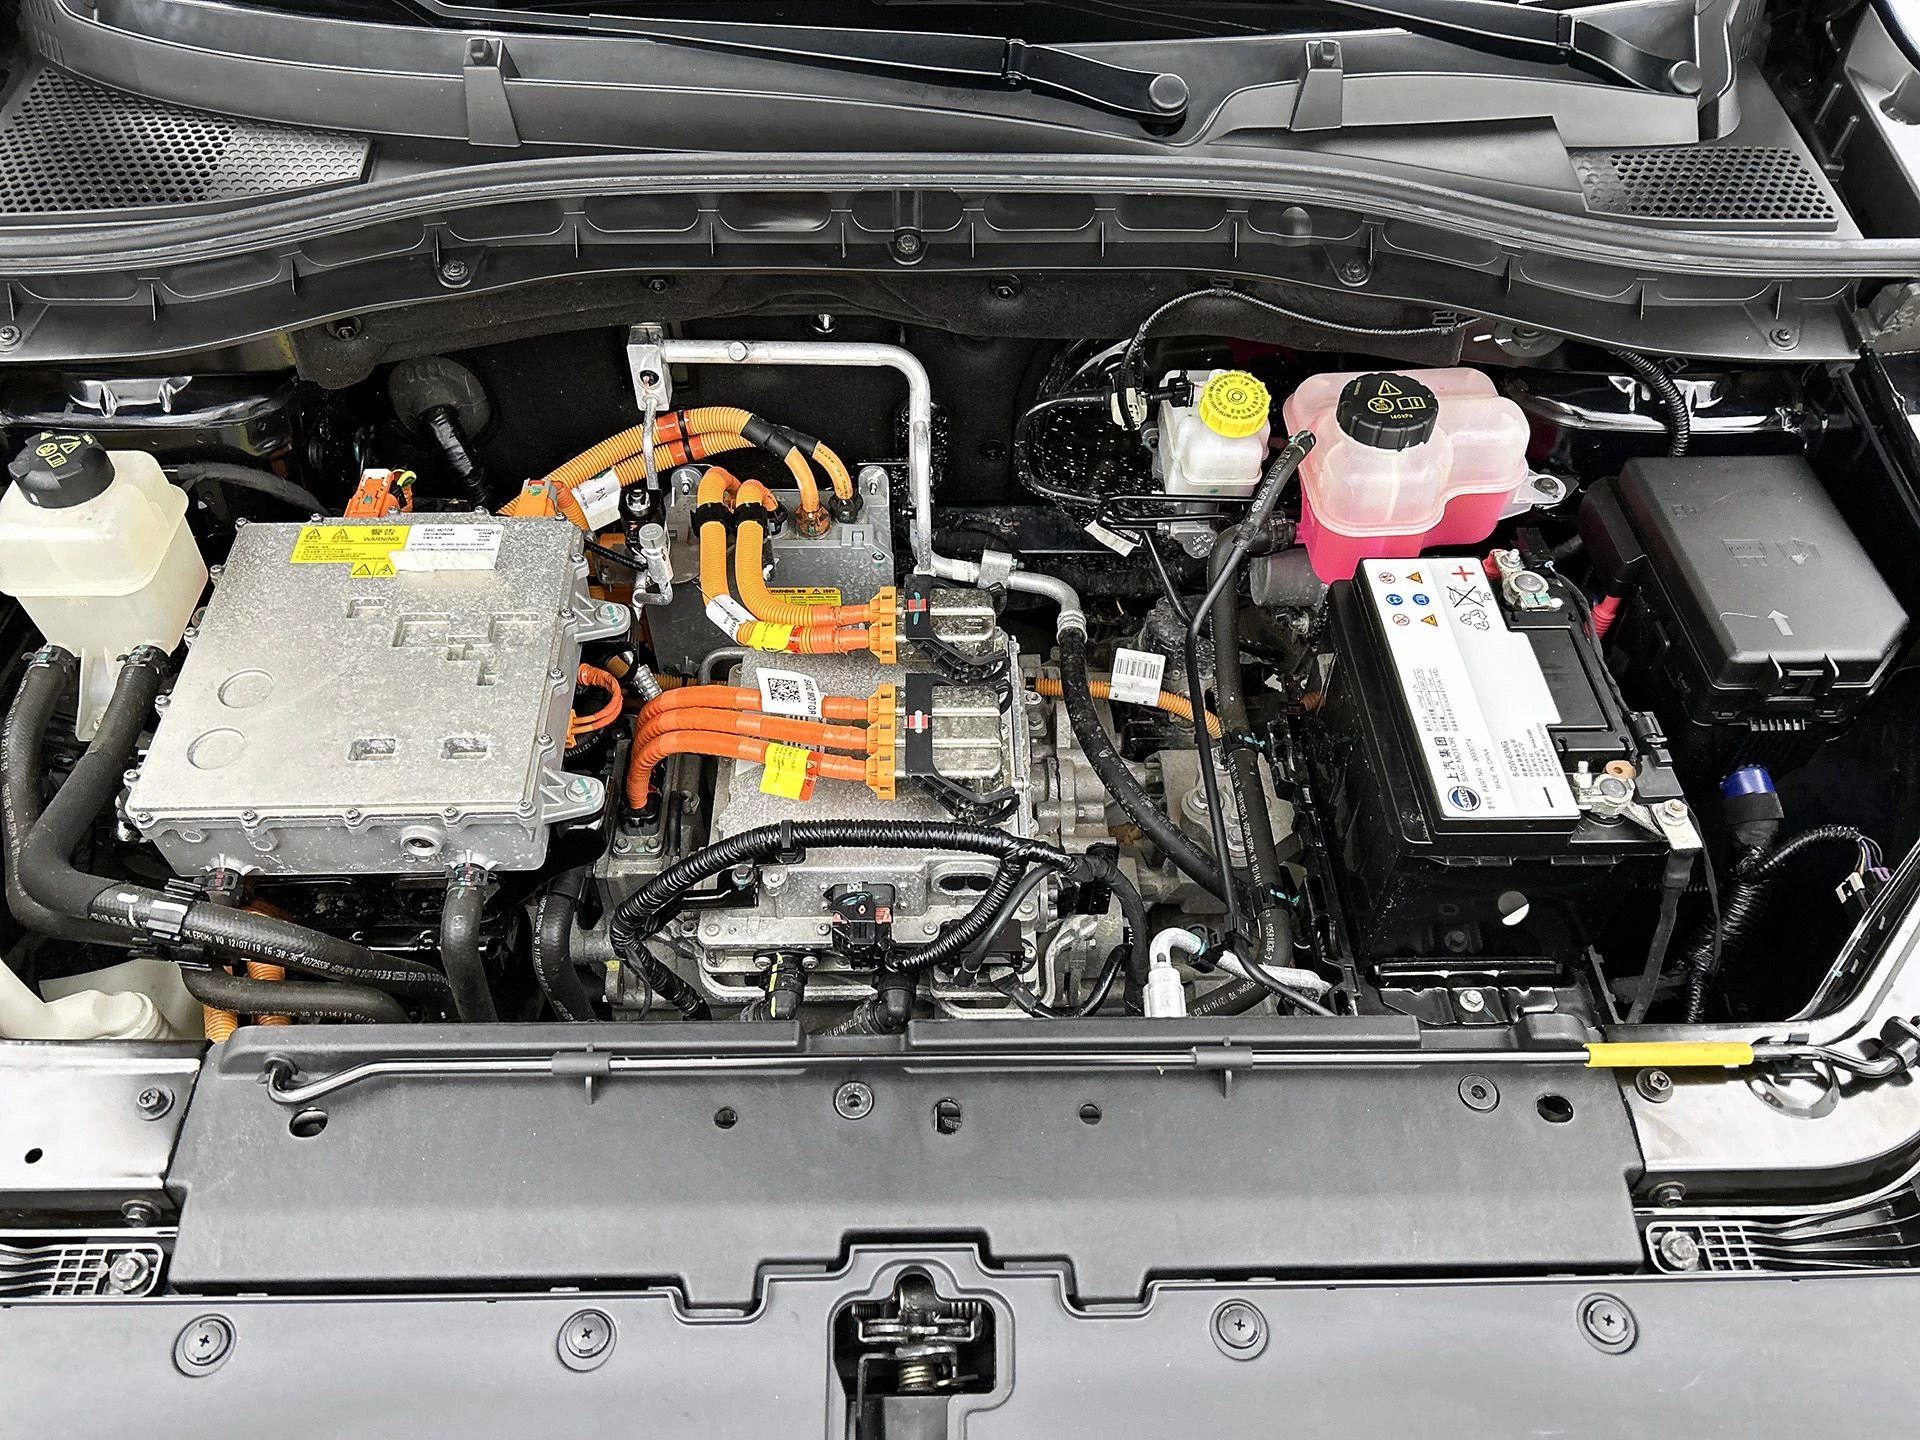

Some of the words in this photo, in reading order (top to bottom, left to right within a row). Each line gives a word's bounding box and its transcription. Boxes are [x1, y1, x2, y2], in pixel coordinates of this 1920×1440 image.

[807, 693, 817, 716] MOTOR
[1433, 736, 1460, 782] 上汽集团
[1446, 736, 1463, 763] MOTOR
[1455, 764, 1469, 782] SAIC
[1458, 788, 1471, 808] SAIC
[215, 935, 225, 945] VQ
[228, 939, 261, 953] 12/07/19
